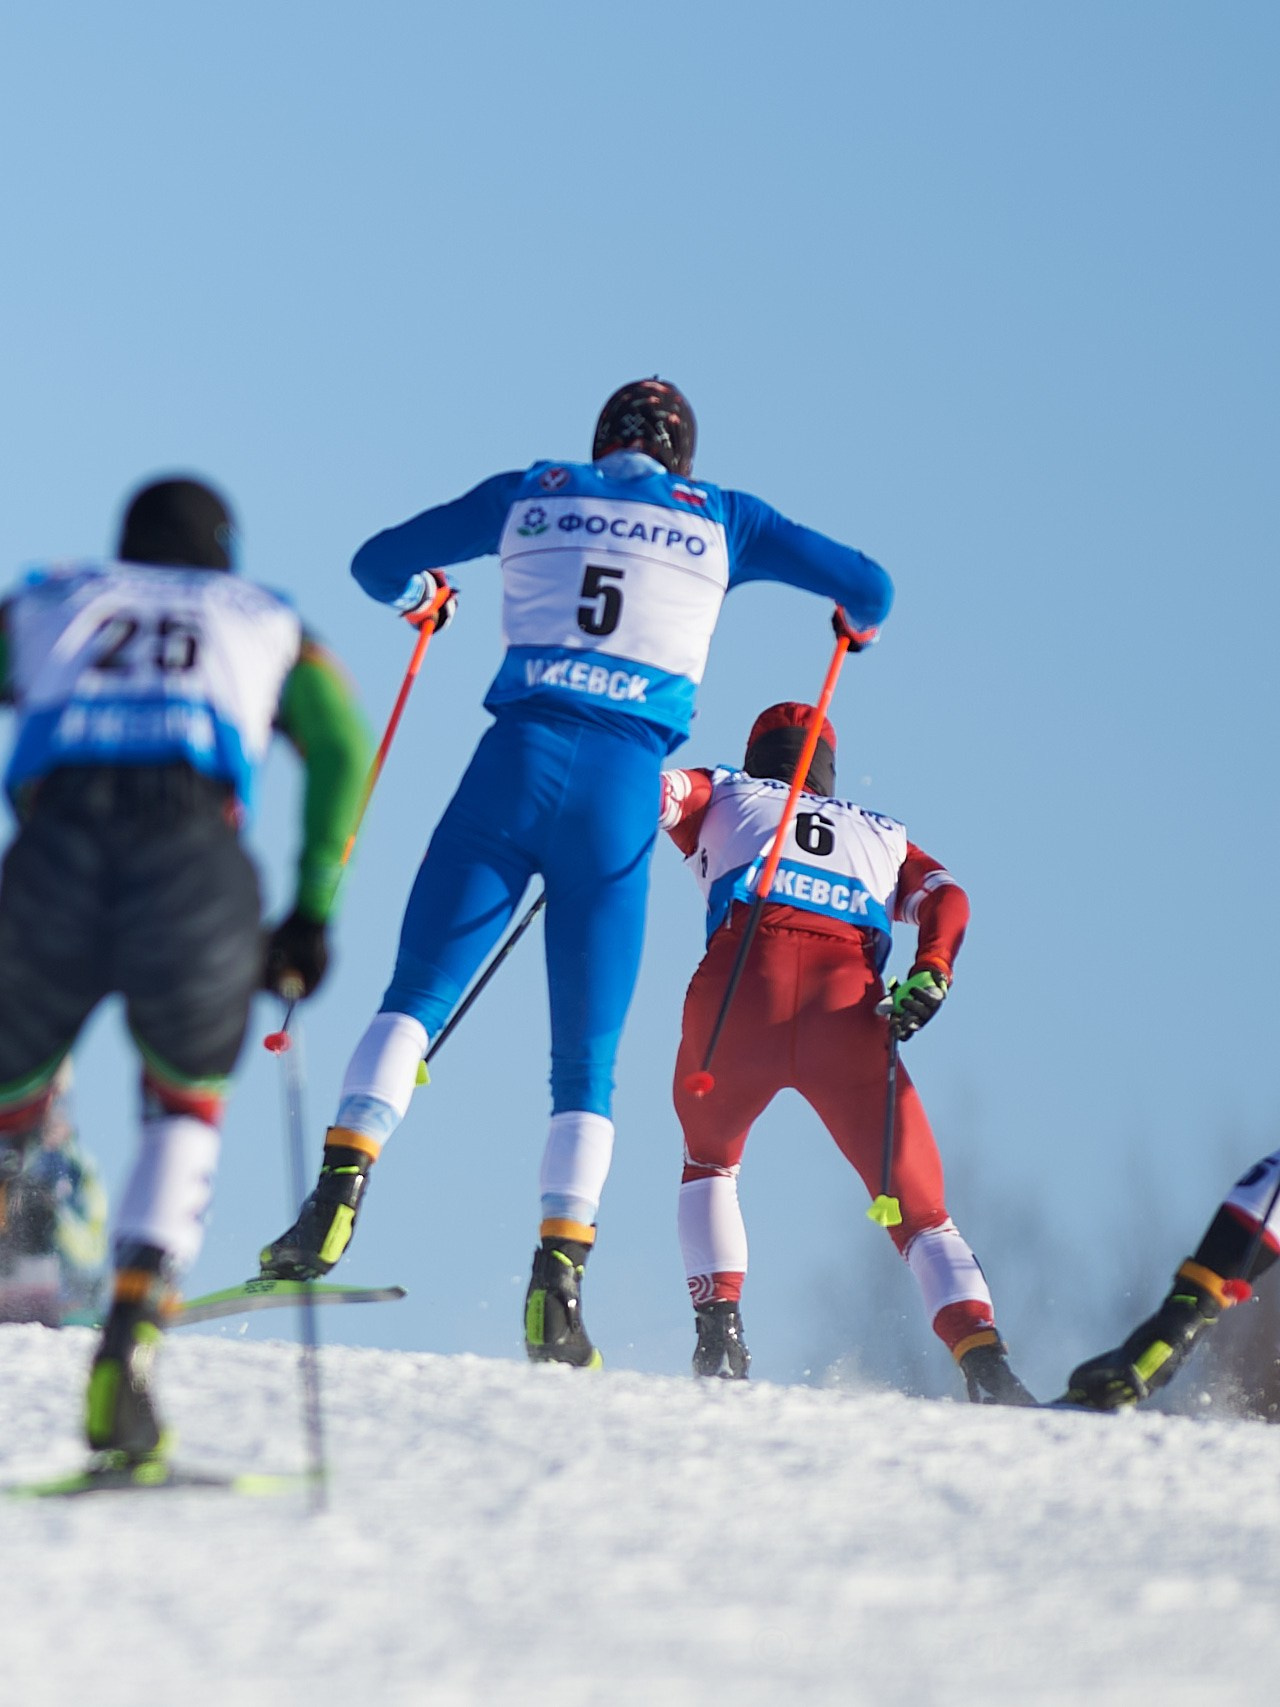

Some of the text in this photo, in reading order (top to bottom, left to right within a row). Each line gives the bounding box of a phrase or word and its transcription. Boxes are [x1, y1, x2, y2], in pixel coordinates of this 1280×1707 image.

[558, 512, 706, 557] ФОСАГРО
[577, 564, 625, 636] 5
[524, 657, 650, 704] ИЖЕВСК
[795, 812, 835, 856] 6
